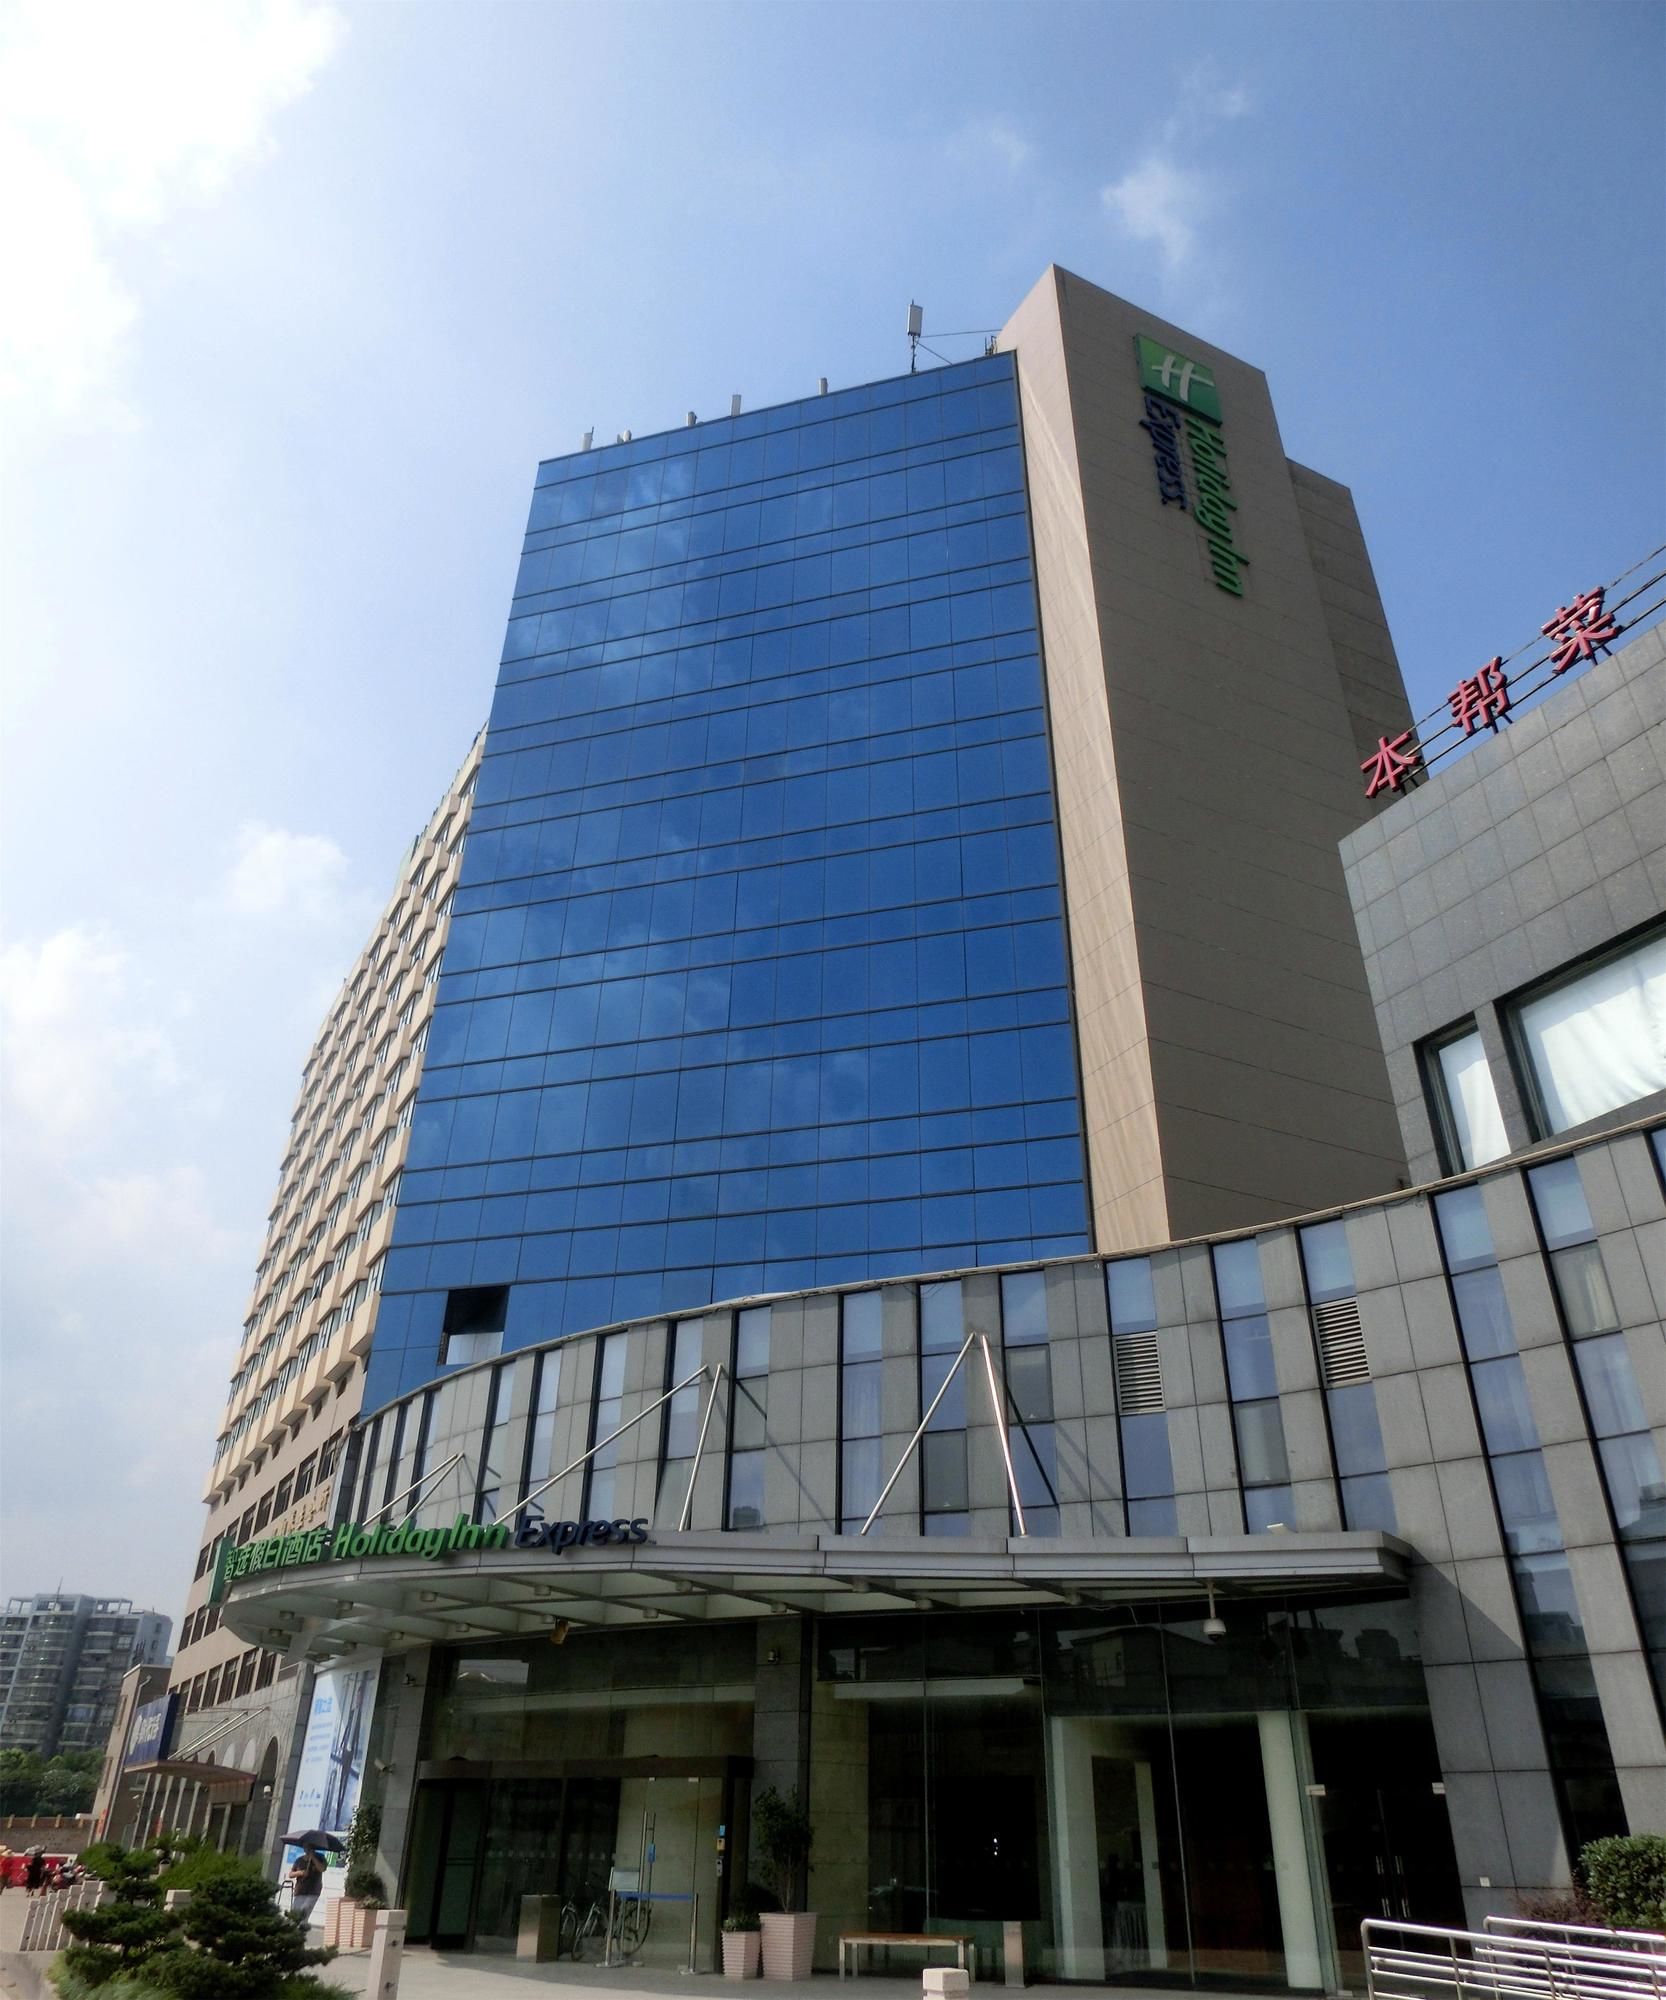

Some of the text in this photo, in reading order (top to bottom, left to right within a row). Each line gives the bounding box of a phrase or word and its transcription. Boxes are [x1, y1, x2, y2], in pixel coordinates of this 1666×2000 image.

[1139, 395, 1188, 511] Express
[1185, 417, 1250, 598] Holiday Inn
[1360, 586, 1624, 799] 本帮菜
[223, 1527, 330, 1582] 智选假日酒店
[332, 1512, 649, 1561] Holiday Inn Express
